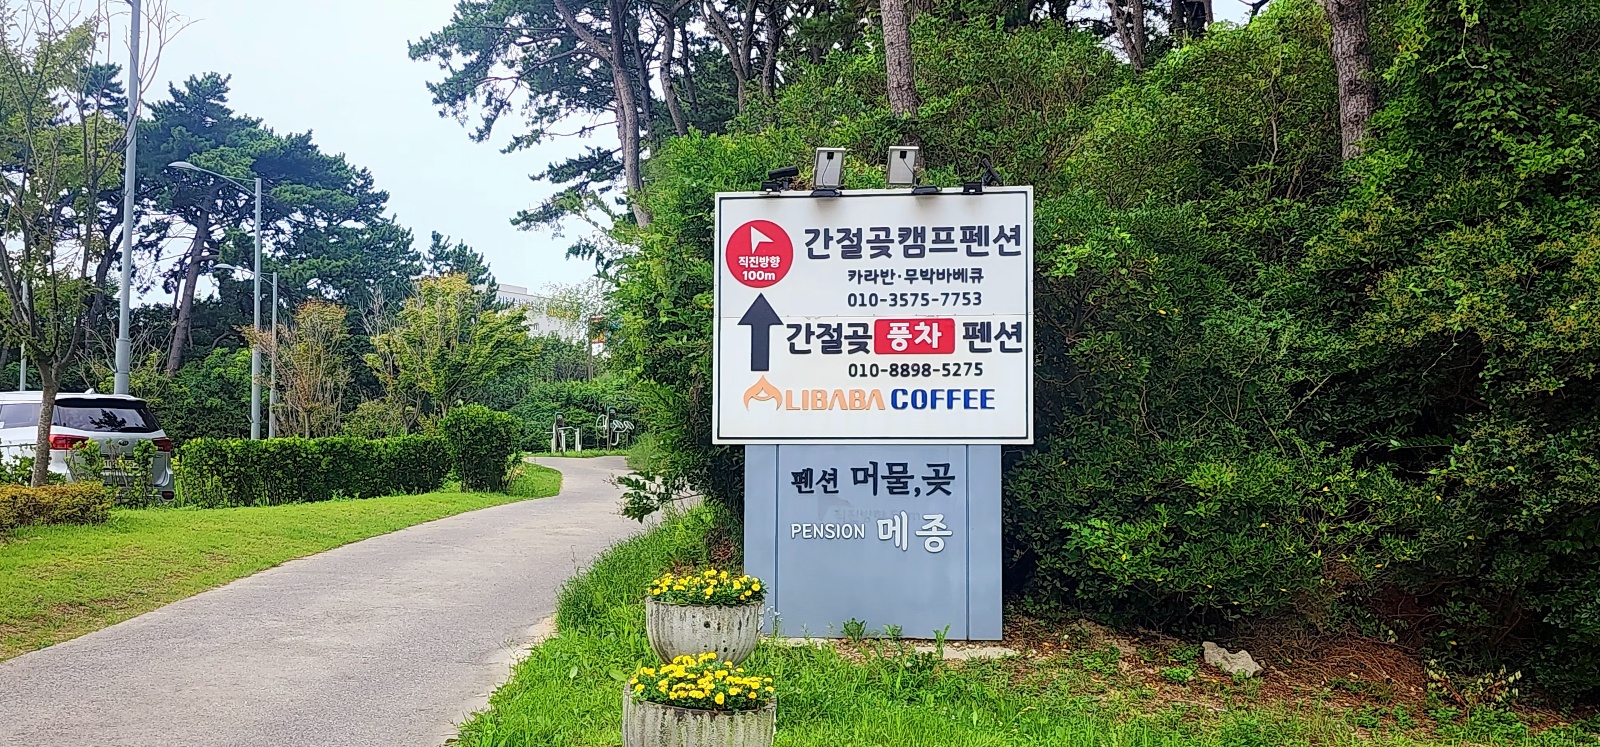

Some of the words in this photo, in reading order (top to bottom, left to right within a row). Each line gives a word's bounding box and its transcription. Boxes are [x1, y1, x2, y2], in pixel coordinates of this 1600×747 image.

[804, 224, 1022, 260] 간절곶캠프펜션
[738, 256, 781, 268] 직진방향
[742, 270, 776, 281] 100m
[847, 291, 983, 307] 010-3575-7753
[786, 322, 873, 354] 간절곶
[887, 322, 942, 352] 풍차
[962, 321, 1023, 354] 펜션
[848, 362, 983, 377] 010-8898-5275
[890, 388, 996, 410] COFFEE
[791, 467, 840, 494] 펜션
[791, 523, 866, 540] PENSION
